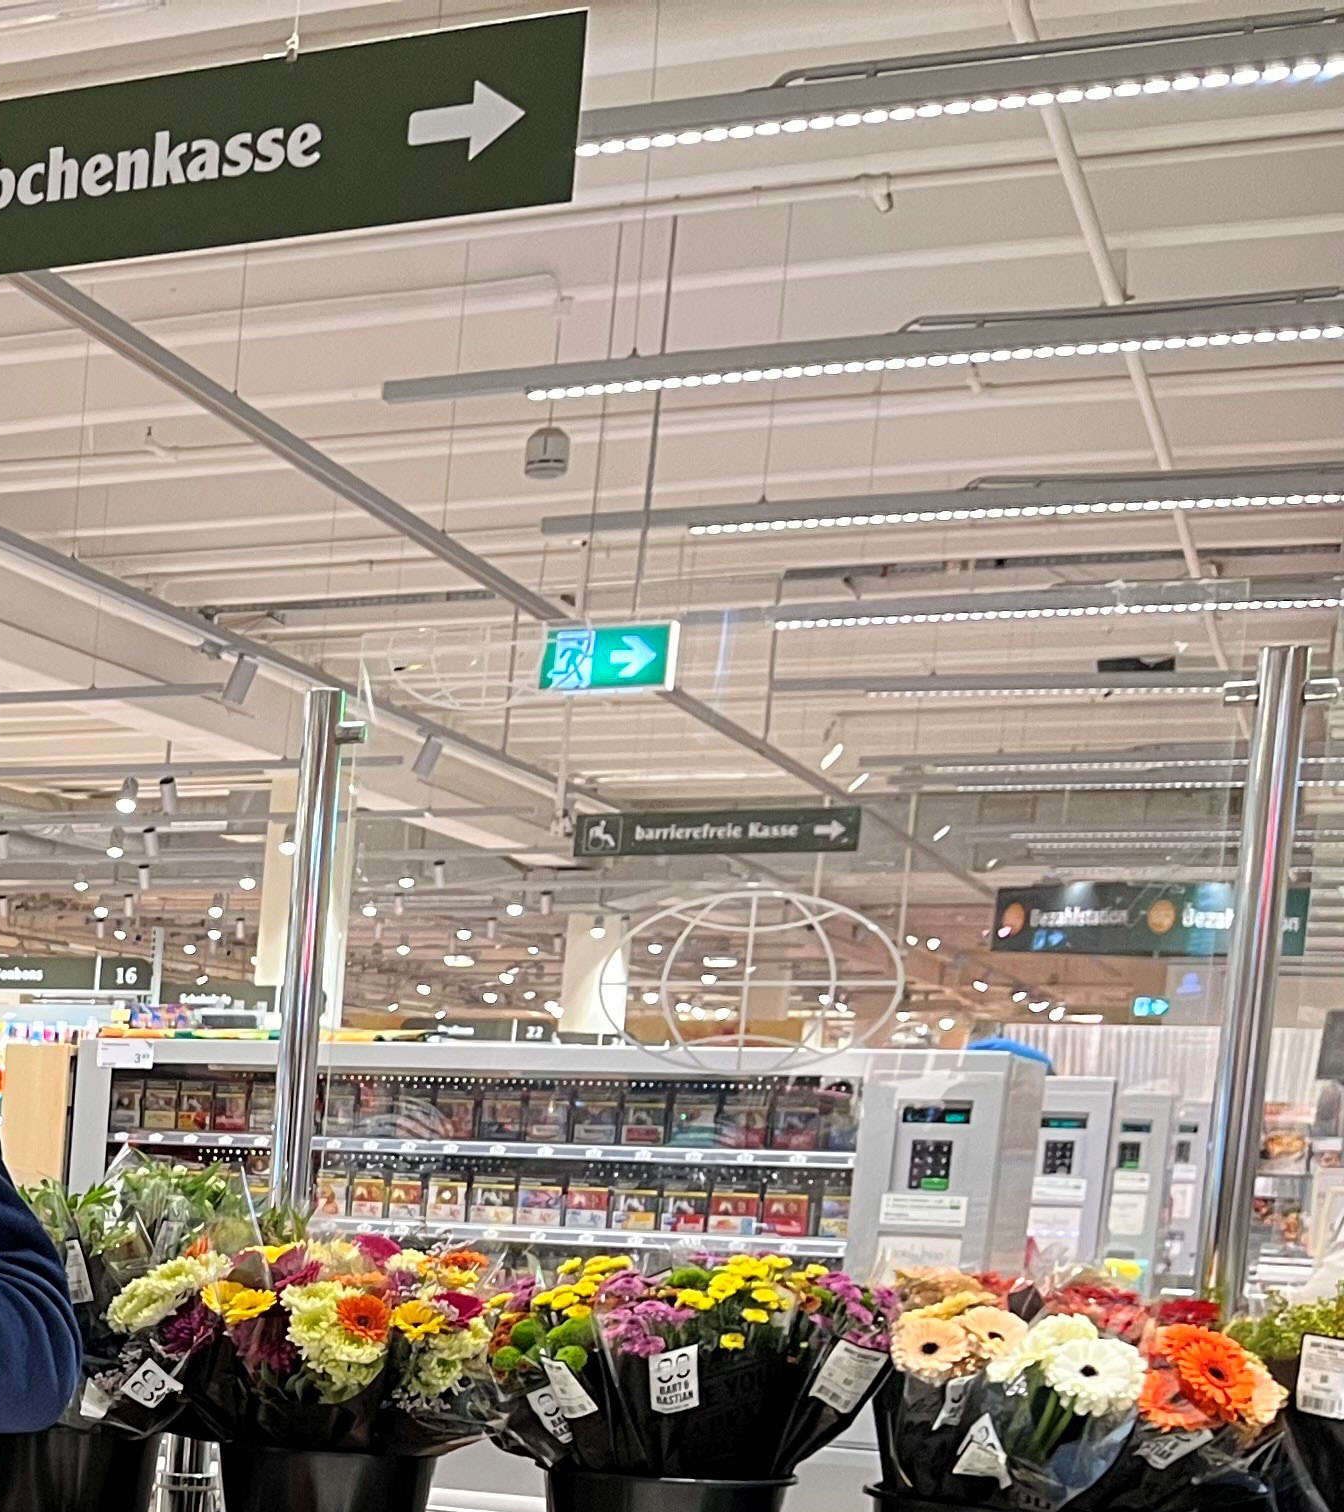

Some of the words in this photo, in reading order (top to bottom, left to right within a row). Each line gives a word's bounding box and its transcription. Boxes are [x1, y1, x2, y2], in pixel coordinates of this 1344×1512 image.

[634, 823, 743, 841] barrierefreie
[748, 822, 799, 838] Kasse
[114, 966, 138, 985] 16
